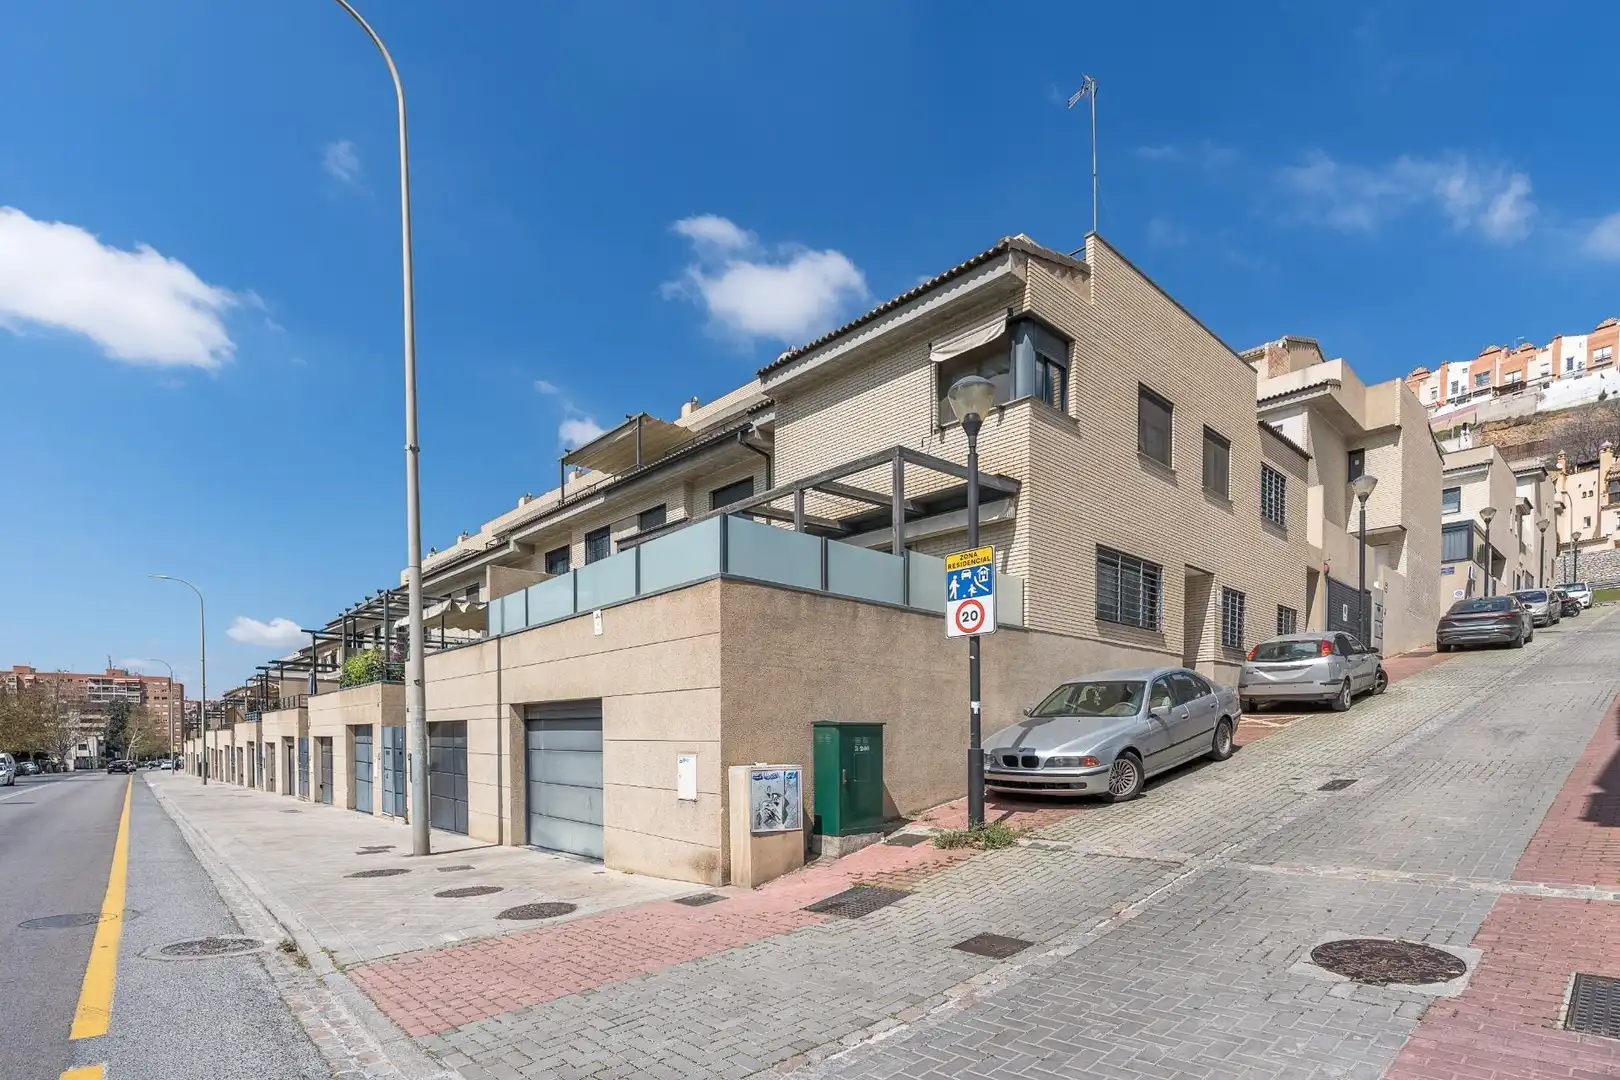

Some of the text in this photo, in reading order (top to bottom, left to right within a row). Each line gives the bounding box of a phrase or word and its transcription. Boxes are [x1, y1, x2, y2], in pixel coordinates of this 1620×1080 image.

[947, 555, 991, 570] RESIDENCIAL
[960, 552, 977, 561] ZONA
[962, 610, 978, 623] 20
